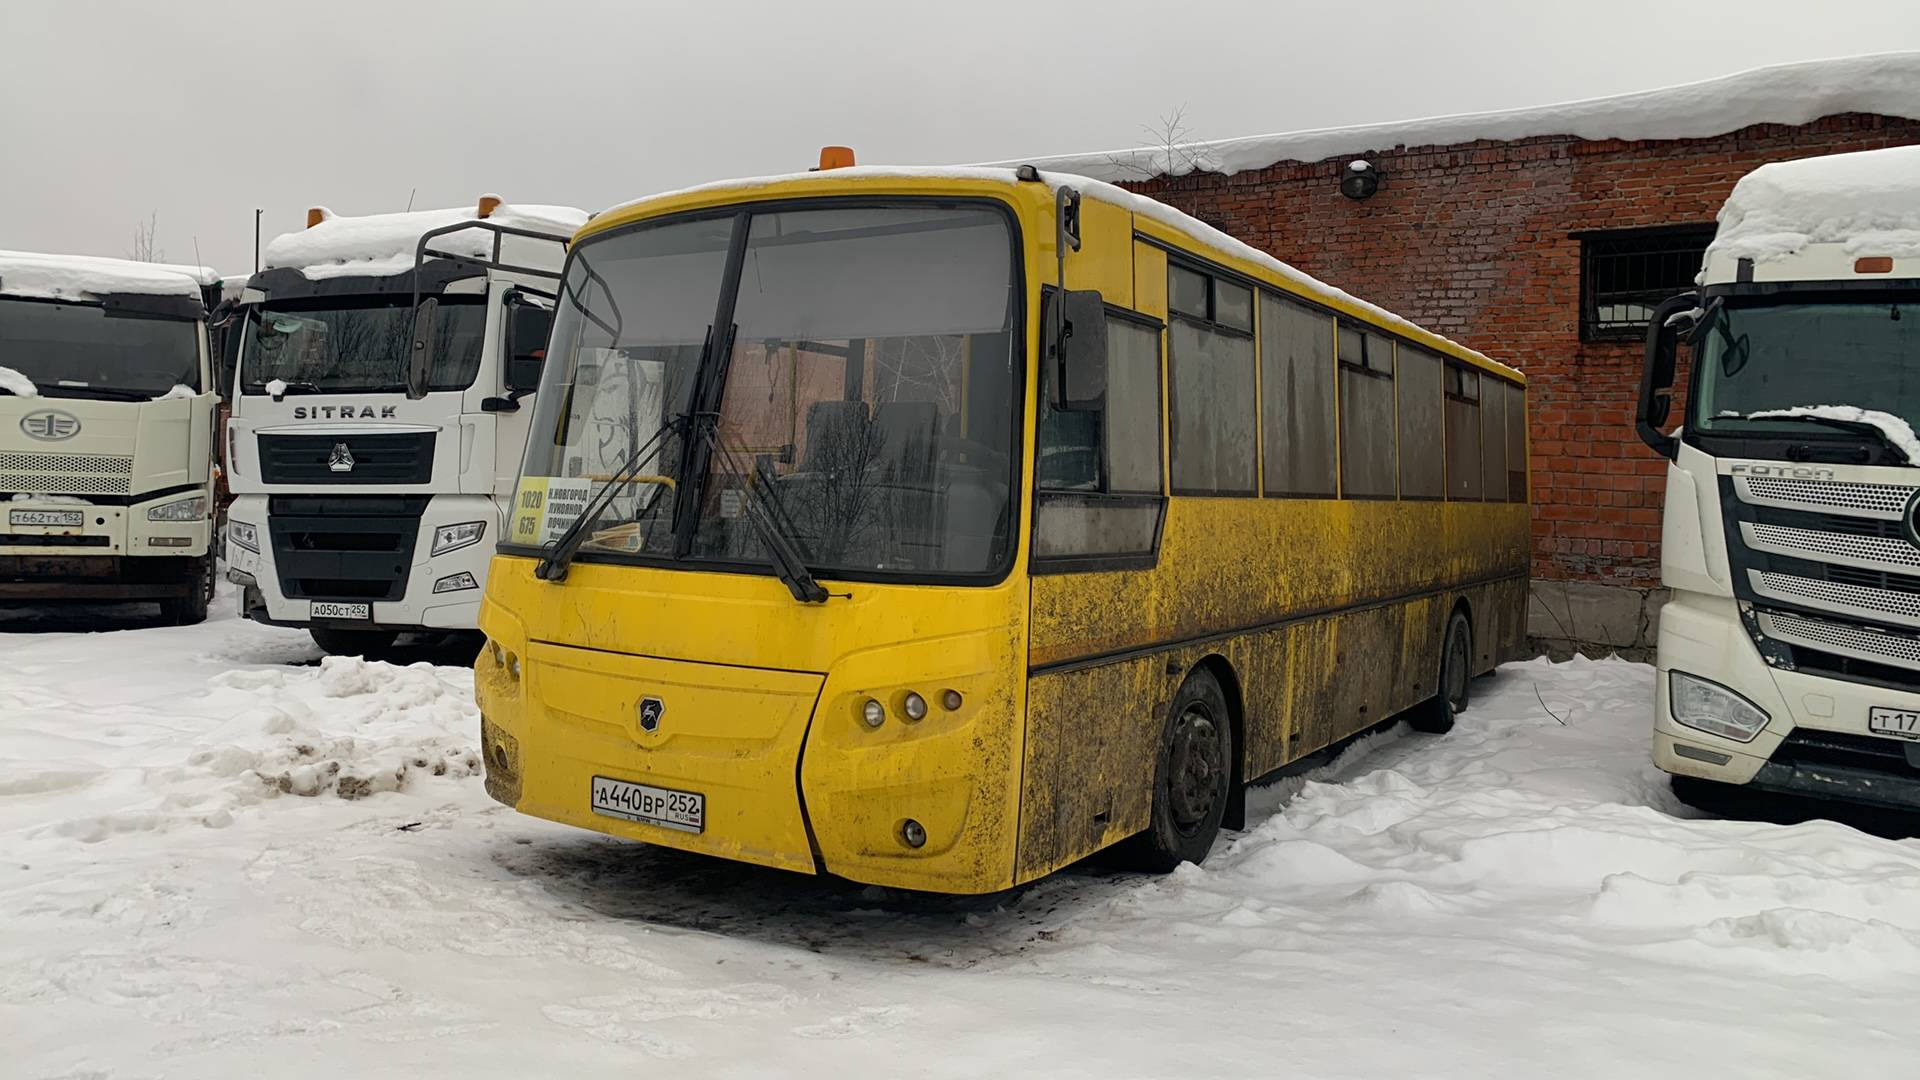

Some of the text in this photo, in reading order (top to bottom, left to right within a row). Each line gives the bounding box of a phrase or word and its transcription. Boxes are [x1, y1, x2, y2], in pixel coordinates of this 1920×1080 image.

[294, 405, 398, 419] SITRAK
[522, 491, 543, 509] 1020
[519, 517, 536, 535] 675
[669, 793, 698, 815] 252
